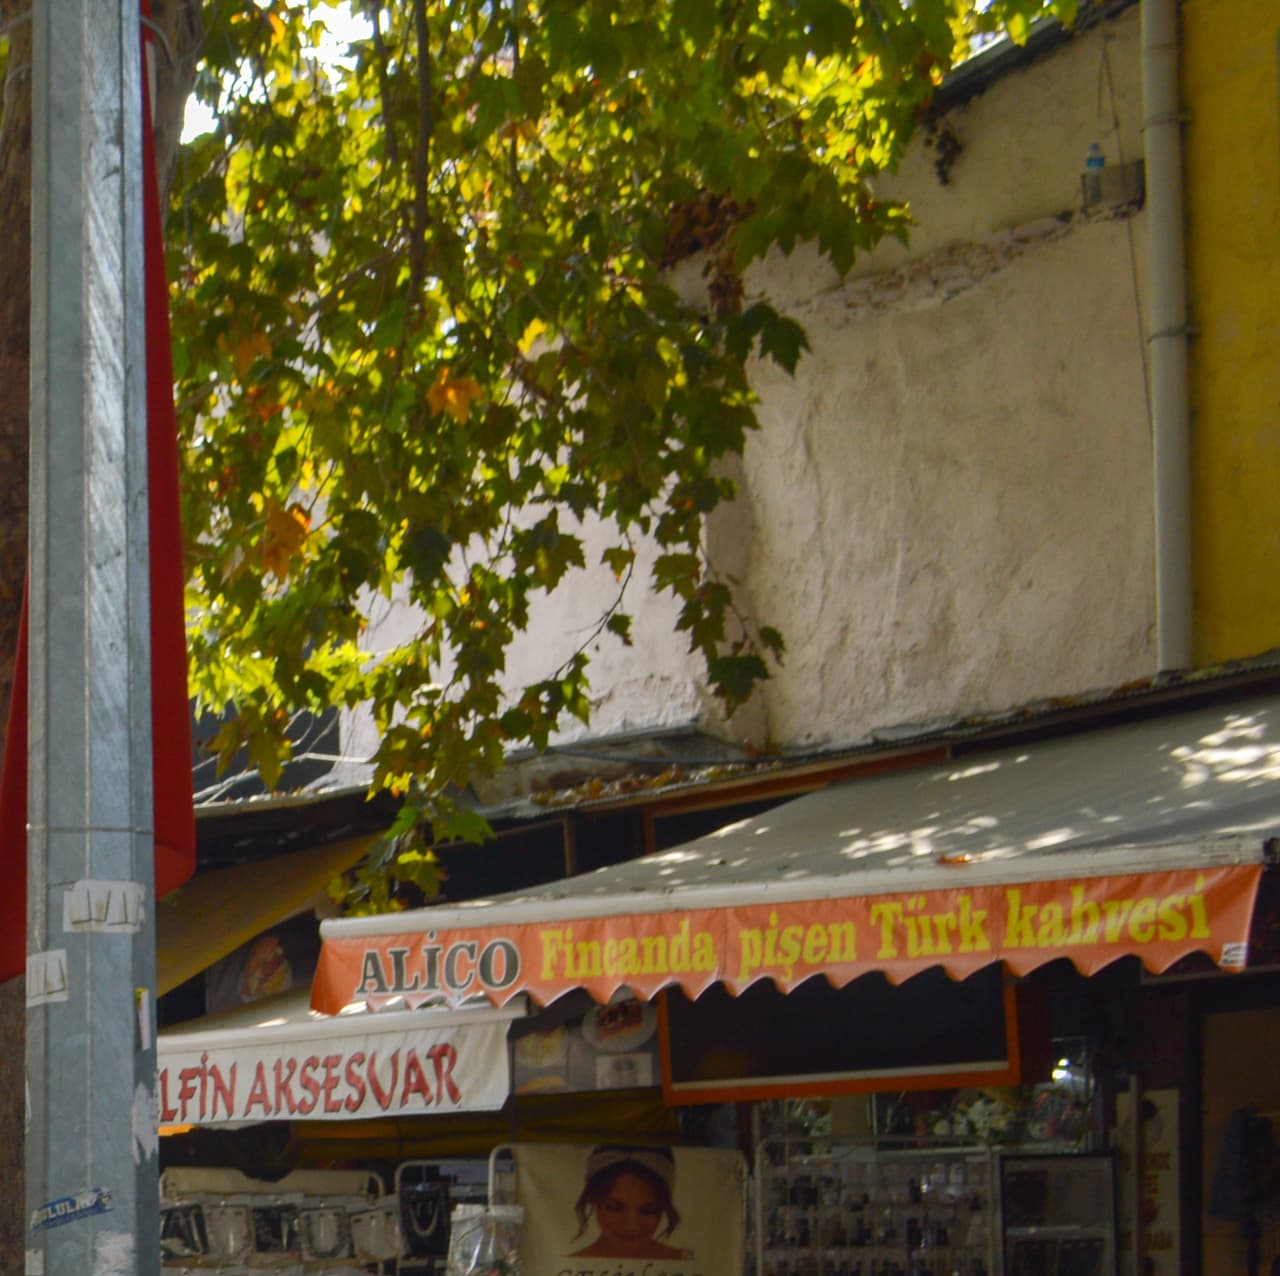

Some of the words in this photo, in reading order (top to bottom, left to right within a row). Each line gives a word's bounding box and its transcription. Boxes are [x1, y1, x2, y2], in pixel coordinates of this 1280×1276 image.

[540, 918, 718, 981] Fincanda
[738, 911, 857, 983] pişen
[871, 893, 992, 960] Türk
[1003, 874, 1211, 949] kahvesi
[158, 1050, 238, 1123] LFİN
[243, 1041, 462, 1118] AKSESUAR
